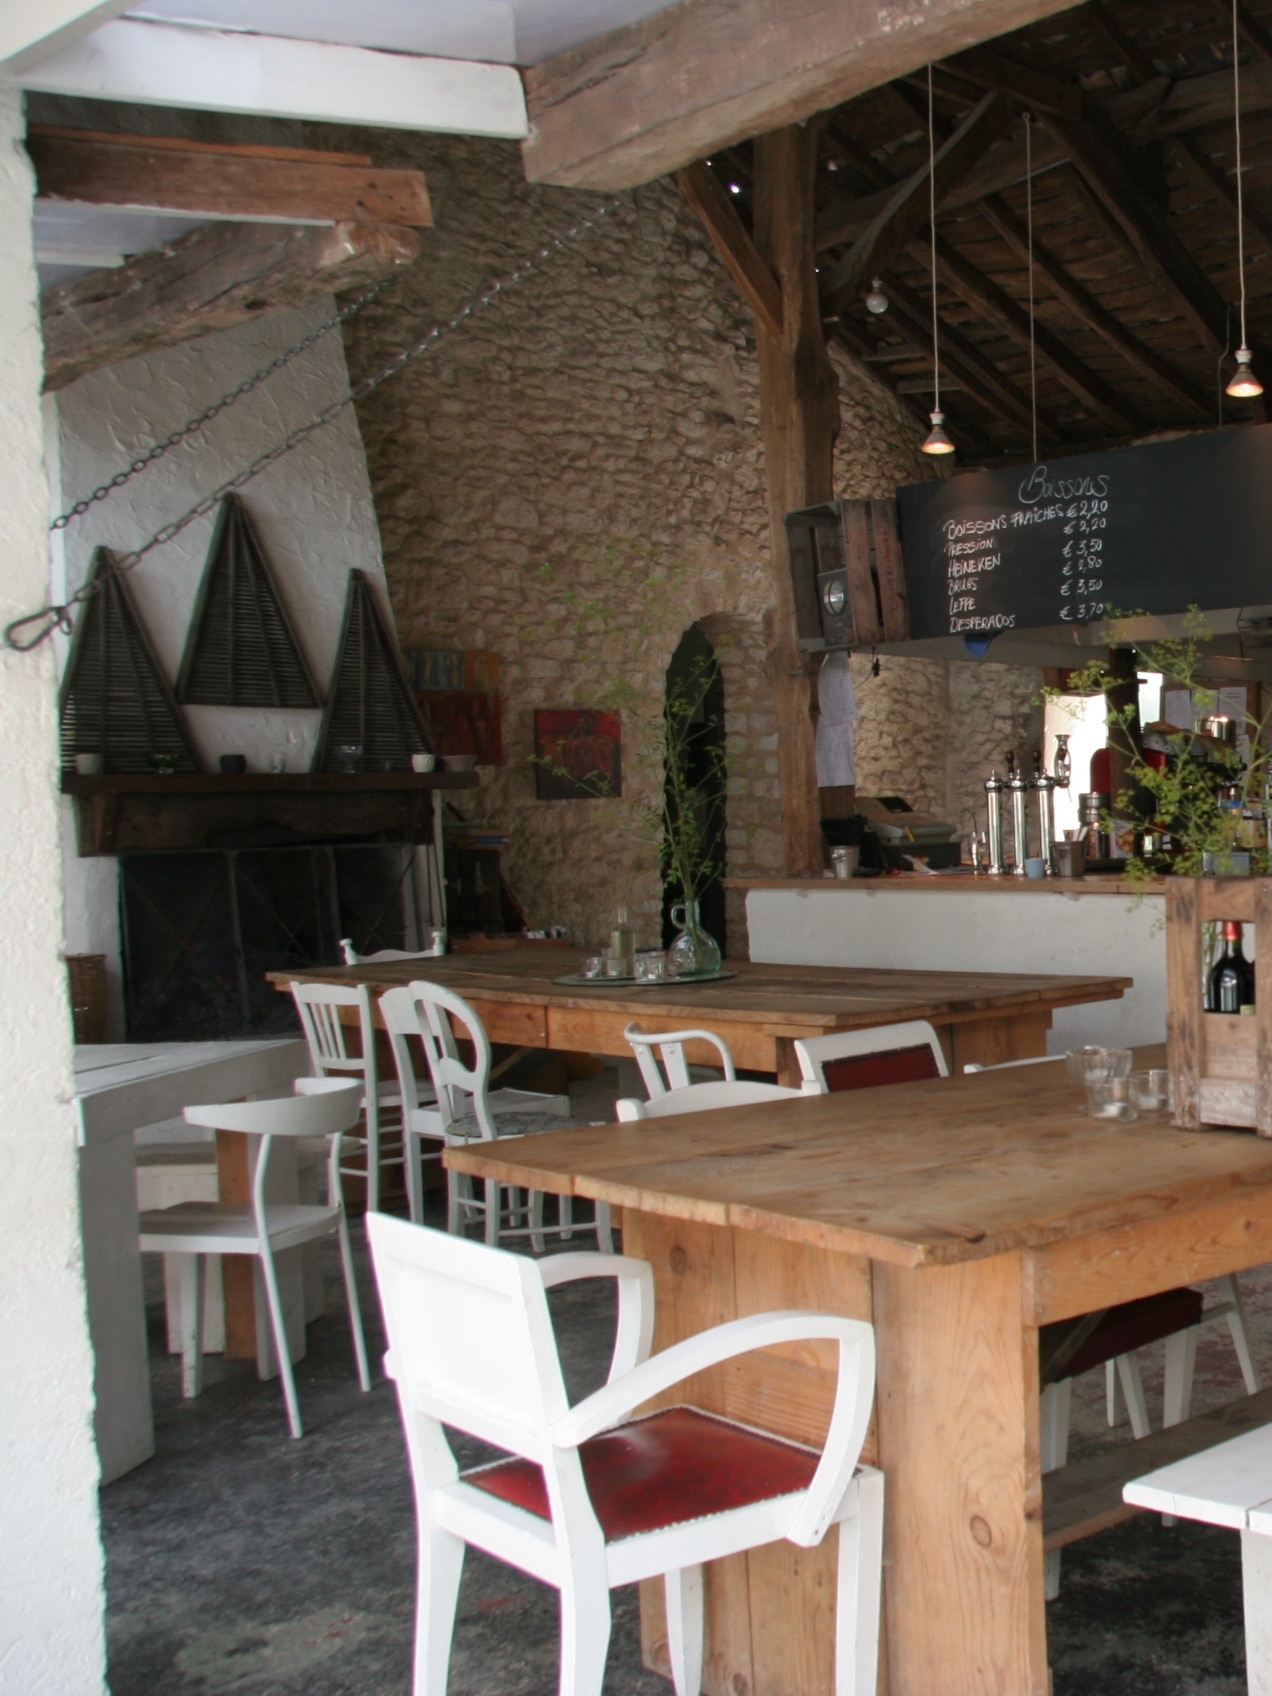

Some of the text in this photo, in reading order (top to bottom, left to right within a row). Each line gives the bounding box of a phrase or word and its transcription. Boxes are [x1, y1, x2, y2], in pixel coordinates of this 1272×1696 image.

[1018, 465, 1109, 504] Boissons
[943, 514, 1008, 540] BOISSONS
[943, 537, 994, 557] PRESSION
[1079, 517, 1106, 534] 2,20
[948, 552, 1001, 578] HEINEKEN
[1076, 538, 1103, 557] 3,50
[949, 596, 976, 616] LEFFE
[1076, 579, 1103, 595] 3,50
[949, 613, 1016, 634] DESPERADOS
[1077, 602, 1104, 620] 3,70
